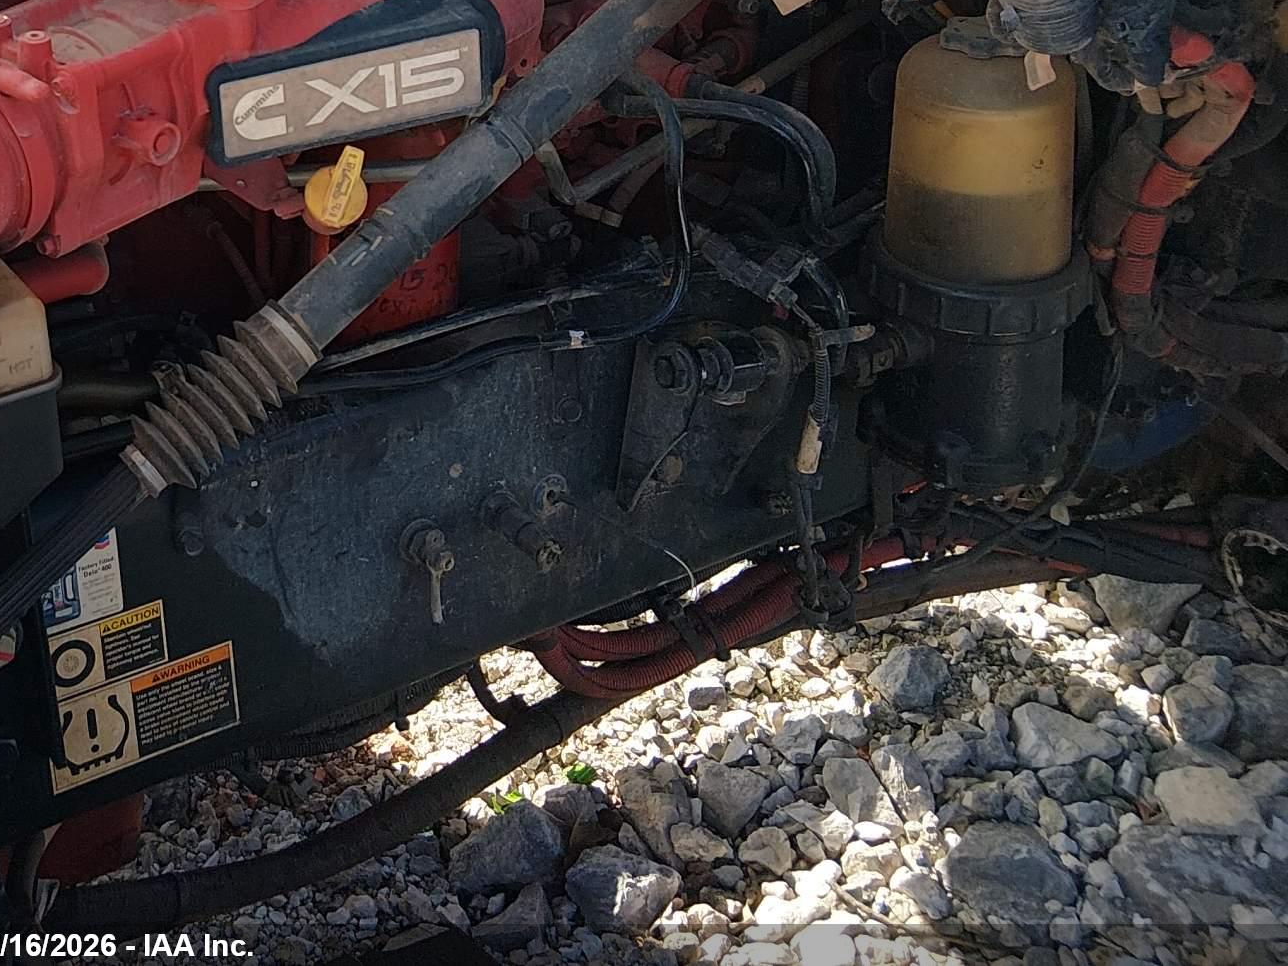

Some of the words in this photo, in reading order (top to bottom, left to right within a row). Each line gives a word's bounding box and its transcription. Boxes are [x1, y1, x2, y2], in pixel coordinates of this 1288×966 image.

[234, 84, 281, 126] Cummins
[111, 606, 159, 630] CAUTION
[160, 655, 210, 679] WARNING
